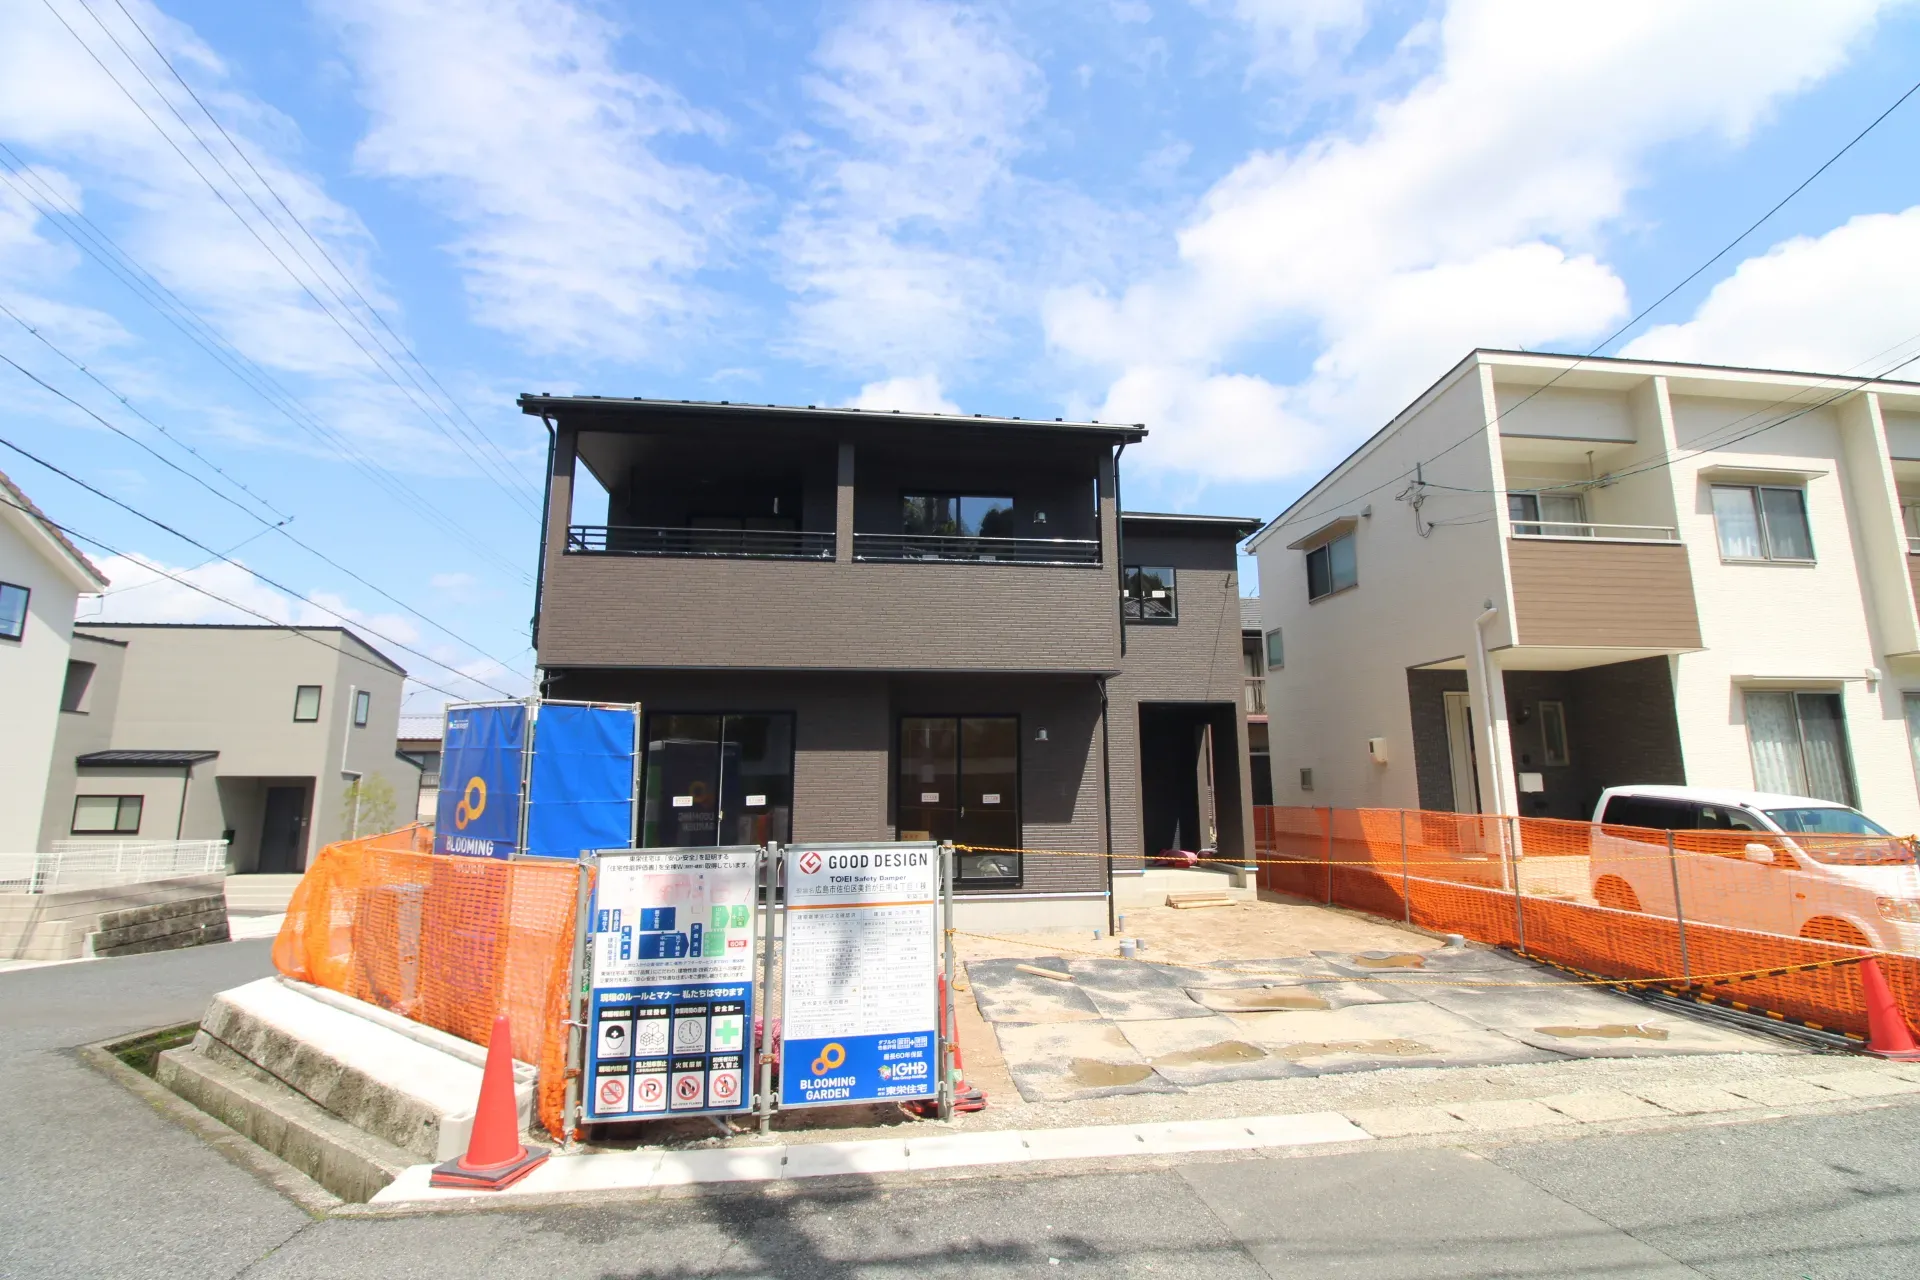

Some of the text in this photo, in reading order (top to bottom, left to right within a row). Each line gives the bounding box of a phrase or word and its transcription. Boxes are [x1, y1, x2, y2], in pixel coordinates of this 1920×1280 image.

[446, 836, 494, 856] BLOOMING
[829, 853, 928, 869] GOOD DESIGN
[854, 875, 877, 883] Safety
[879, 874, 906, 882] Damper
[683, 987, 745, 999] 私たちは守ります
[800, 1076, 856, 1090] BLOOMING
[806, 1087, 850, 1100] GARDEN
[886, 1084, 928, 1096] 東栄住宅
